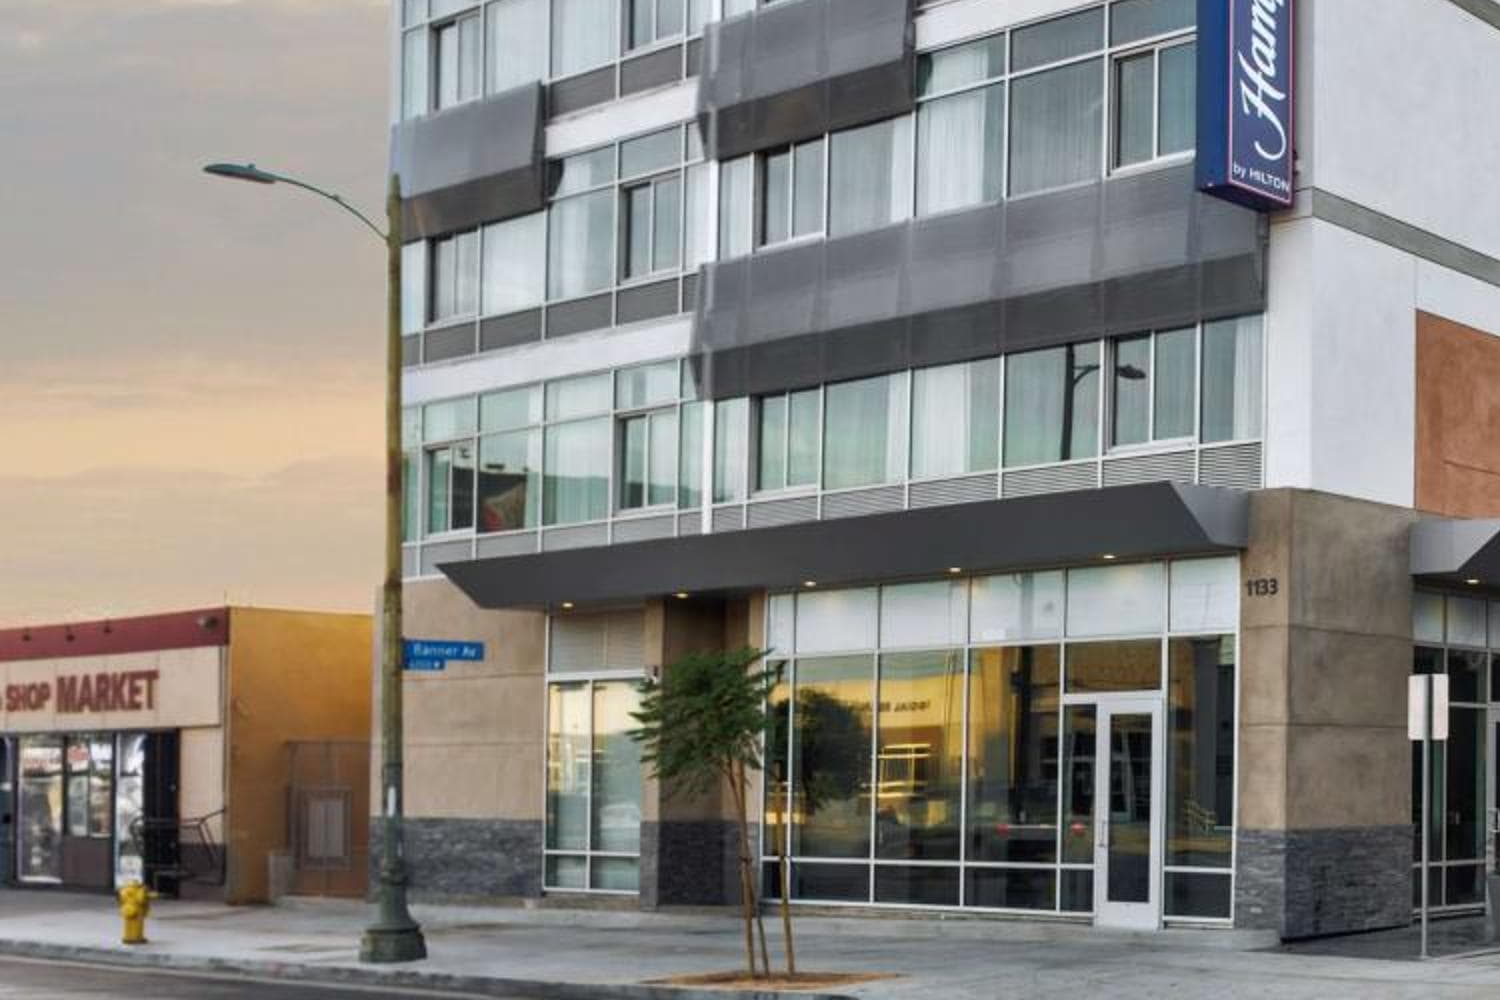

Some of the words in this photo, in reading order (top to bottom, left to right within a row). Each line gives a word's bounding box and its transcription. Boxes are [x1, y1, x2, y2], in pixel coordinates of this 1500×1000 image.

[1233, 161, 1246, 179] by
[1249, 167, 1290, 192] HILTON
[1247, 578, 1279, 597] 1133
[5, 681, 51, 712] SHOP
[56, 668, 160, 713] MARKET
